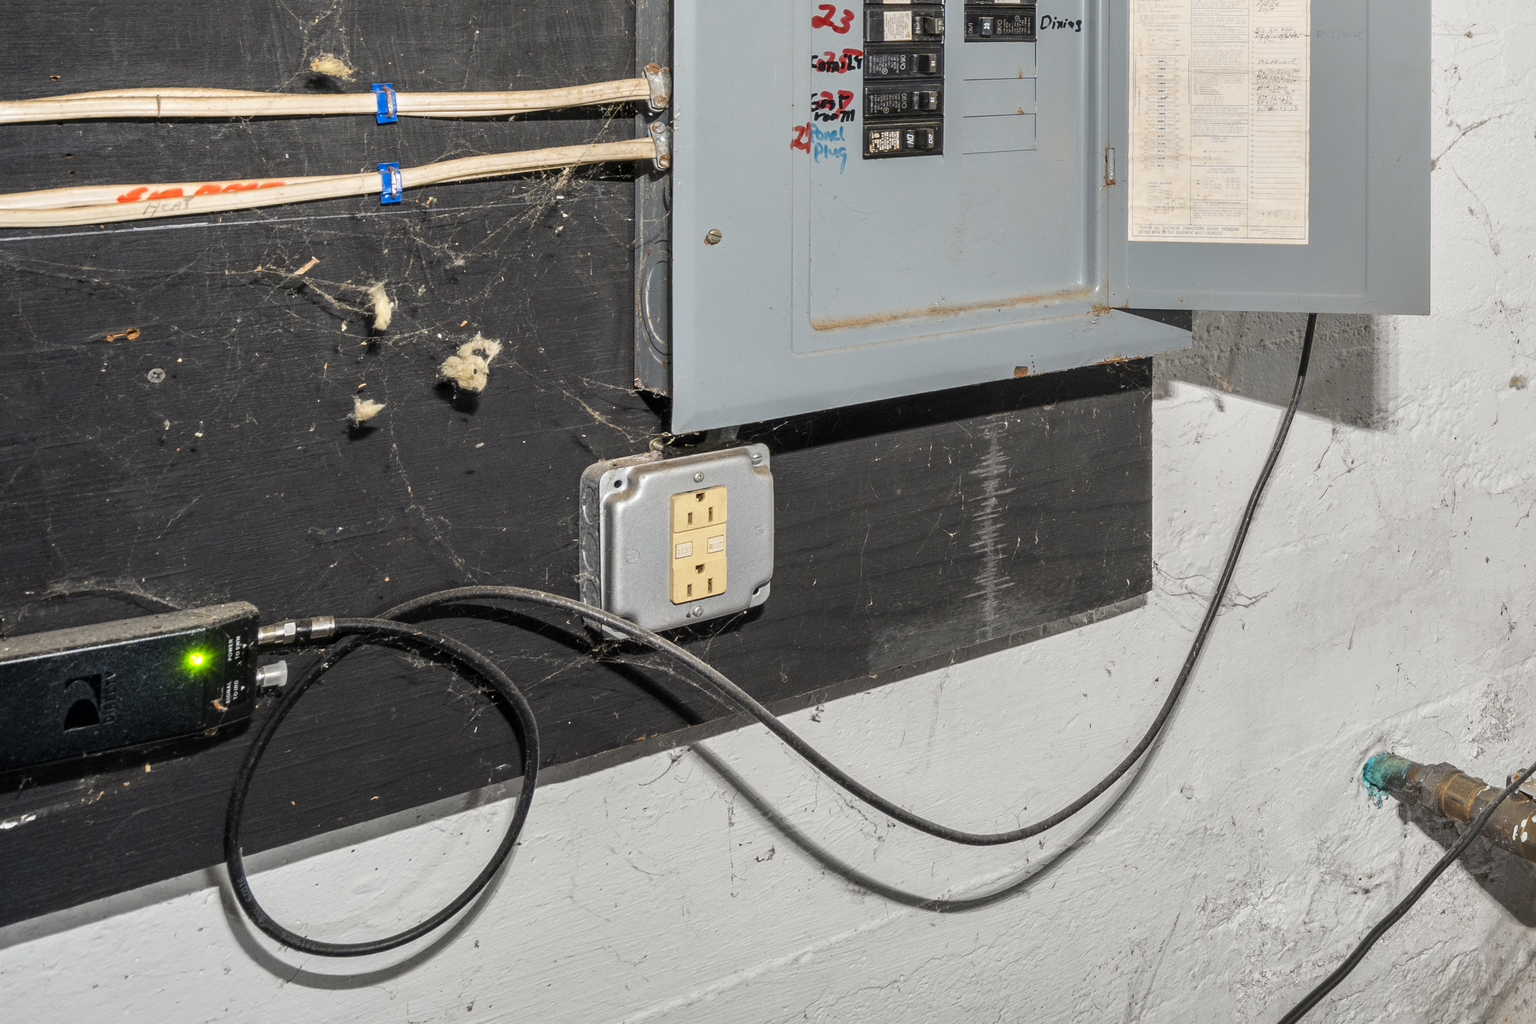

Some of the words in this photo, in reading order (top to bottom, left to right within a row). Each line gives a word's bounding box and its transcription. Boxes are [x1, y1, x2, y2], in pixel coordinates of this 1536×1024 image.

[812, 4, 855, 34] 23
[811, 123, 845, 143] Panel
[676, 545, 693, 555] TEST
[235, 649, 241, 661] TO
[232, 689, 240, 701] TO
